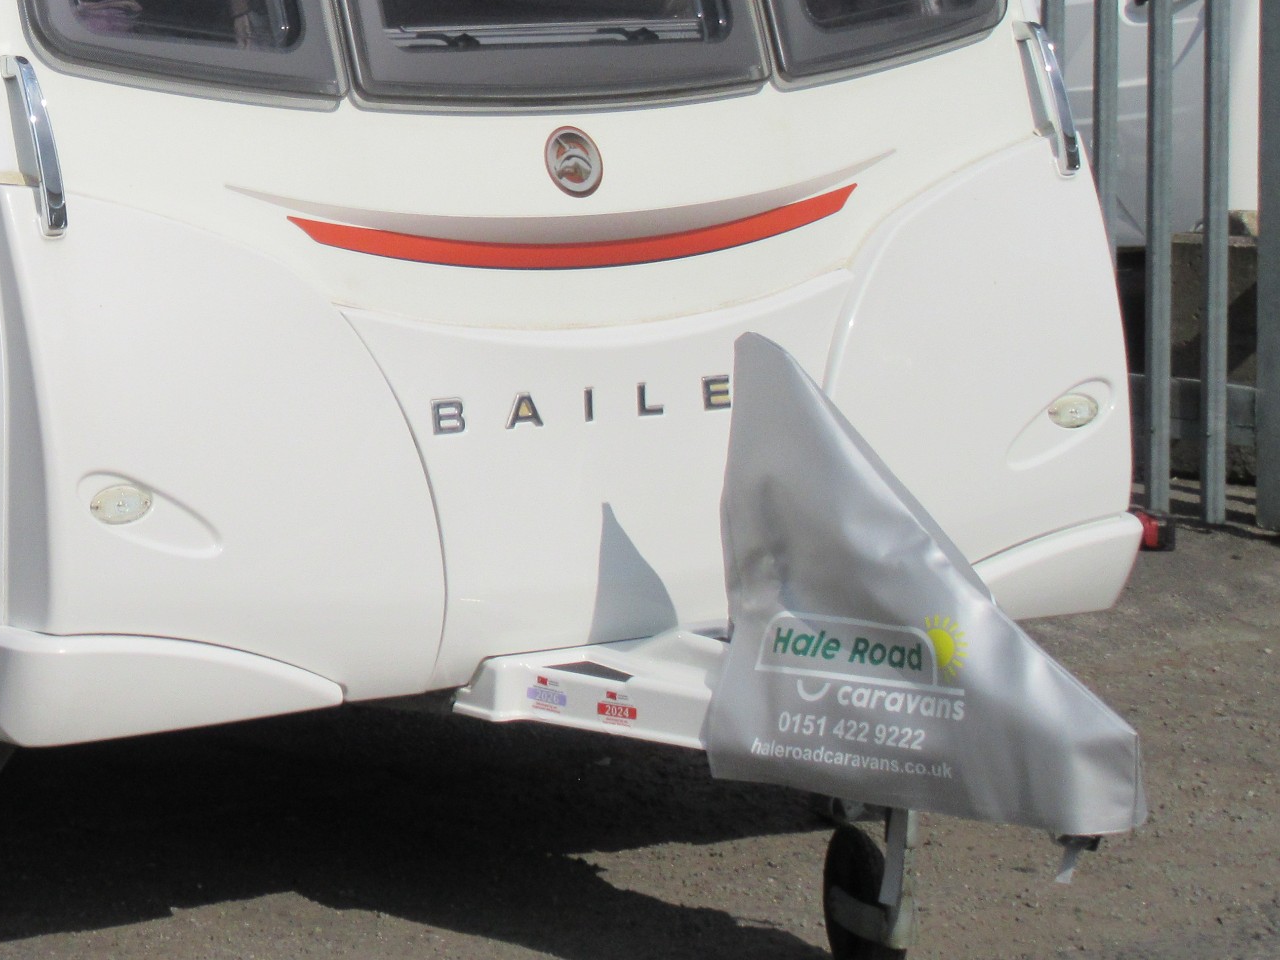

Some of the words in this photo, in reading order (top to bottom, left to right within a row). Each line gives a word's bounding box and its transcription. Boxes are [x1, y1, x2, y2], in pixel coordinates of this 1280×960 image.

[431, 374, 731, 436] BAILE
[772, 626, 841, 660] Hale
[847, 636, 923, 672] Road
[605, 704, 630, 719] 2024
[836, 685, 965, 721] caravans
[778, 711, 827, 737] 0151
[832, 719, 870, 743] 422
[874, 724, 926, 751] 9222
[750, 737, 953, 780] haleroadcaravans.co.uk
